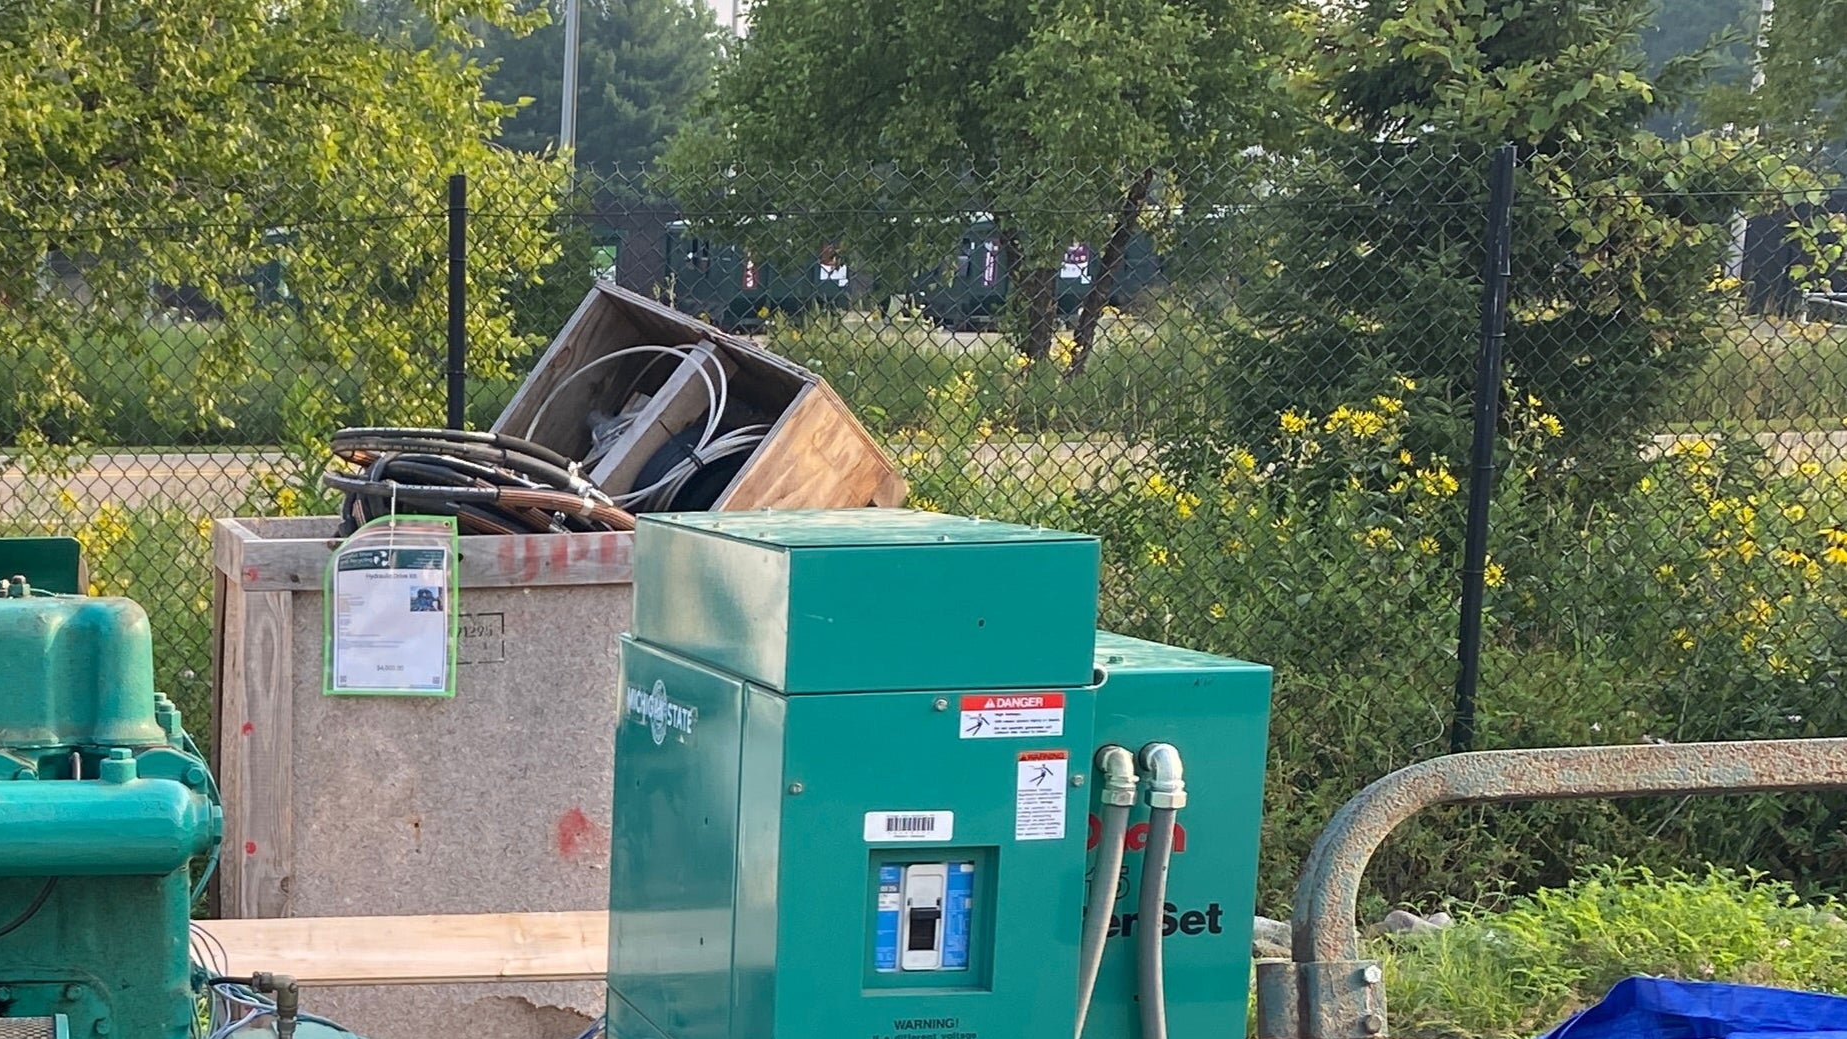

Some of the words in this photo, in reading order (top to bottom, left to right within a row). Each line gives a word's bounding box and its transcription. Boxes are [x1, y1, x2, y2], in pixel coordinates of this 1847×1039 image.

[996, 697, 1044, 708] DANGER
[667, 703, 692, 734] STATE
[894, 1018, 959, 1030] WARNING!
